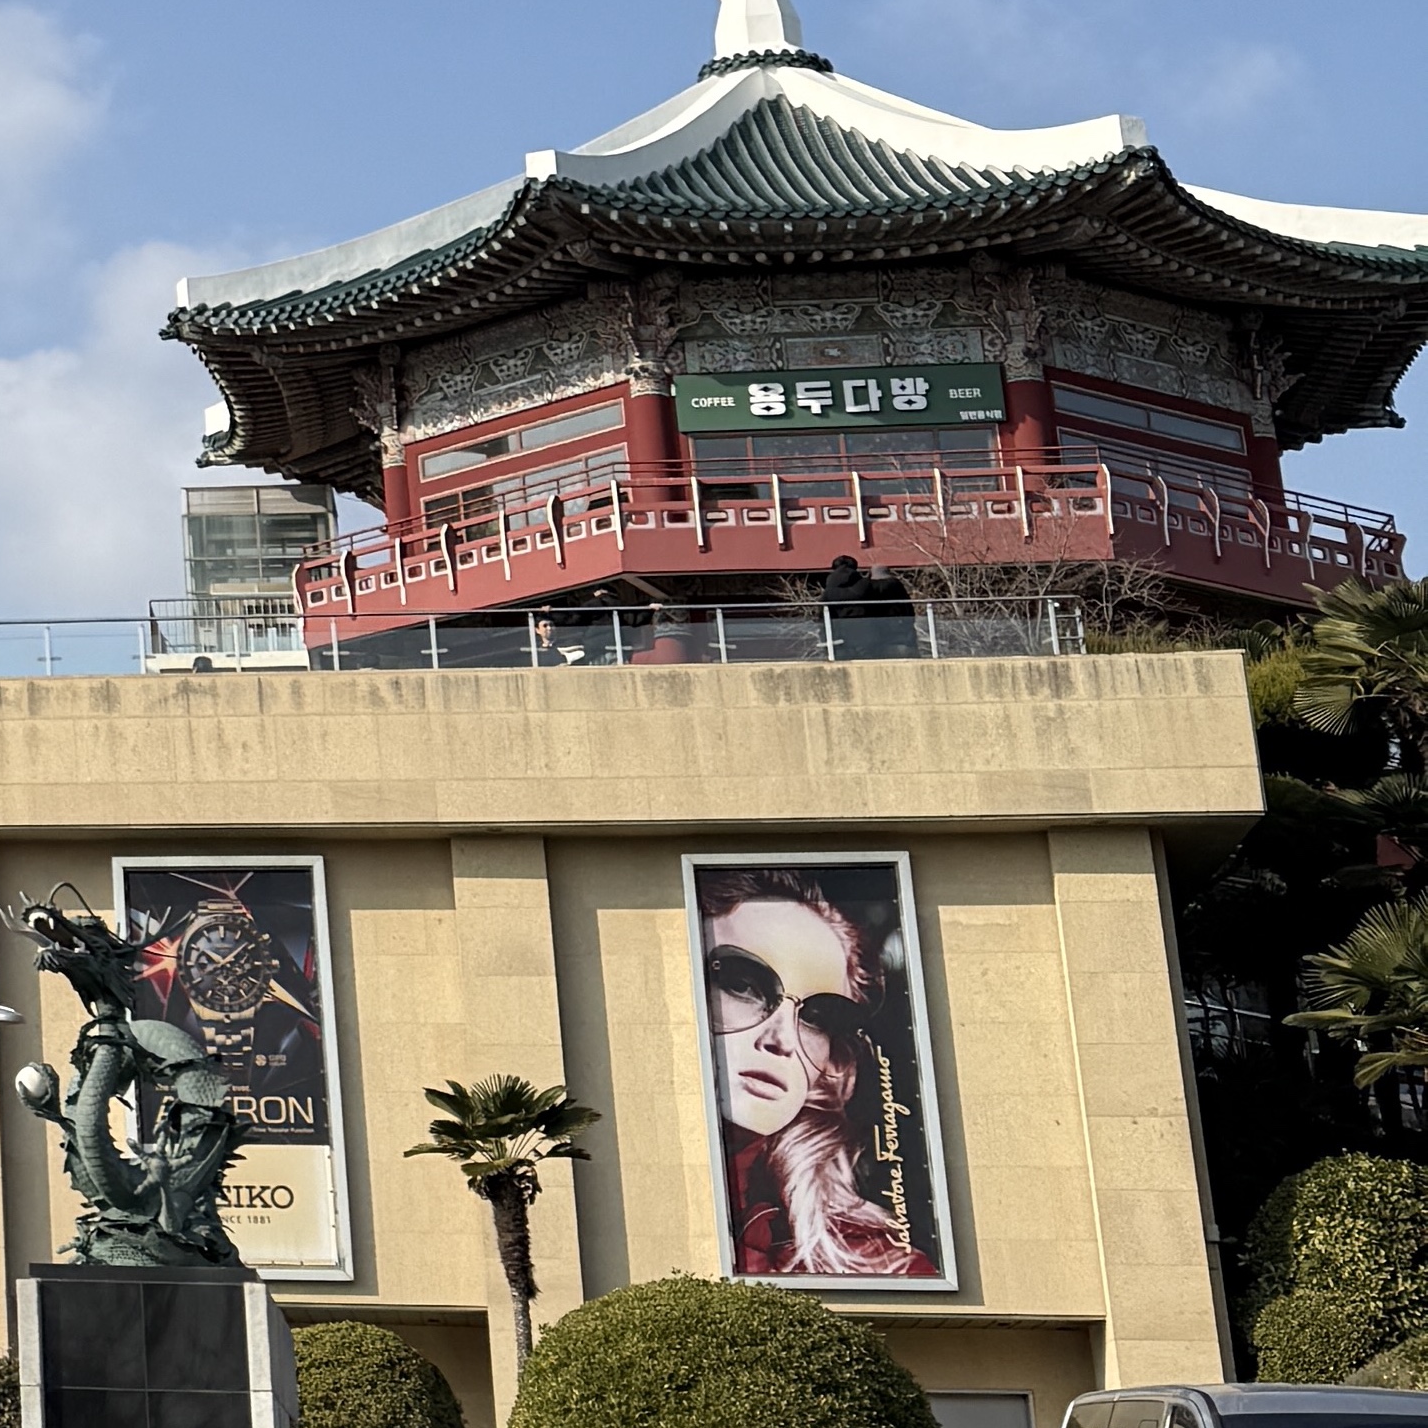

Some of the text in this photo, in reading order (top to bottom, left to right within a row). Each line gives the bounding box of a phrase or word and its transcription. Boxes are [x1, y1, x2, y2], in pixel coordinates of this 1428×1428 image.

[748, 377, 929, 416] 용두다방
[948, 387, 982, 399] BEER
[691, 396, 736, 408] COFFEE
[874, 1045, 912, 1255] Salvatore Ferragamo
[247, 1215, 272, 1224] 1881
